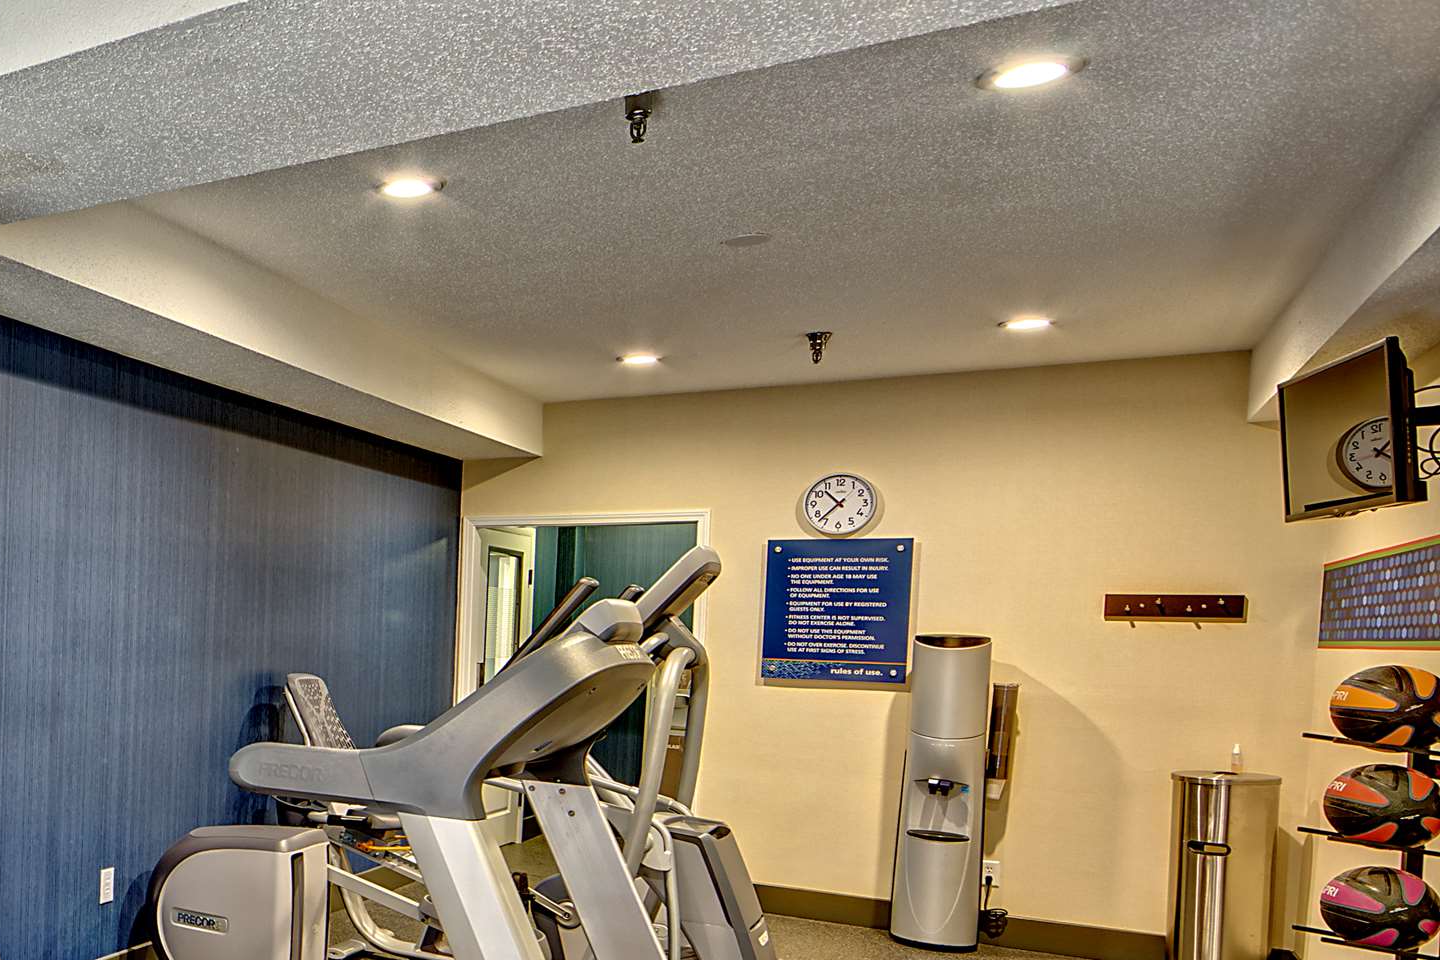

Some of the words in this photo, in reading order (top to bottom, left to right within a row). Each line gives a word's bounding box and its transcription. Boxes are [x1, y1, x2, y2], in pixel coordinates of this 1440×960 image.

[824, 482, 831, 490] 11
[835, 479, 846, 487] 12
[851, 480, 856, 490] 1
[812, 490, 824, 499] 10
[857, 488, 865, 497] 2
[809, 500, 817, 509] 9
[862, 498, 869, 507] 3
[814, 509, 821, 519] 8
[856, 507, 864, 516] 4
[822, 517, 829, 527] 7
[834, 520, 842, 530] 6
[848, 516, 855, 526] 5
[854, 668, 864, 676] of
[176, 912, 217, 930] PRECOR
